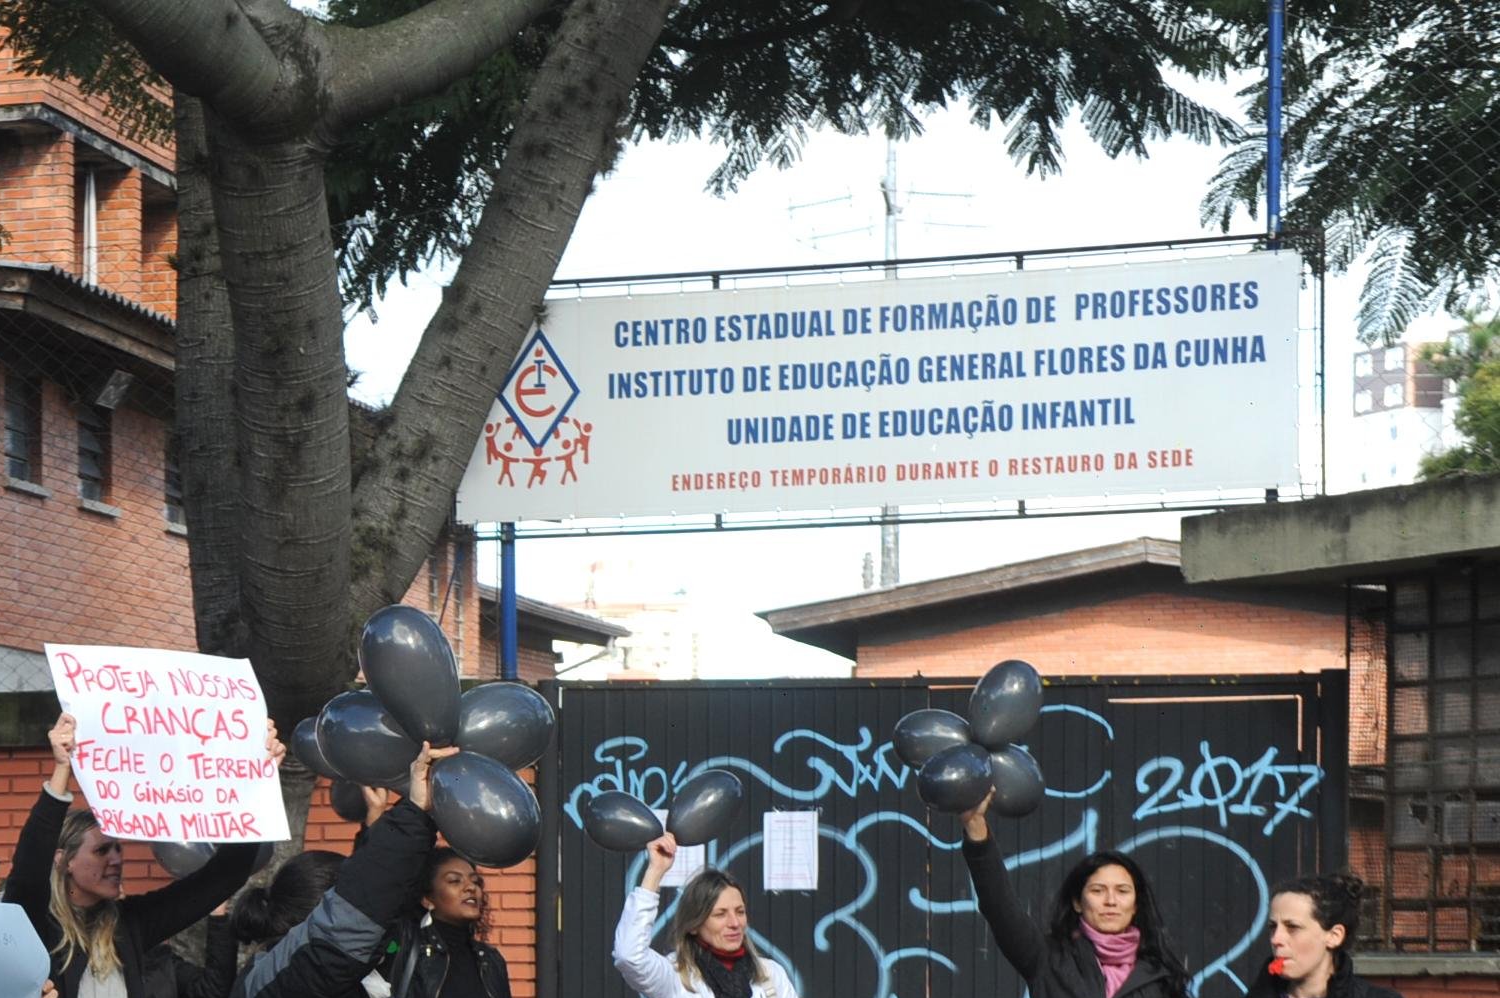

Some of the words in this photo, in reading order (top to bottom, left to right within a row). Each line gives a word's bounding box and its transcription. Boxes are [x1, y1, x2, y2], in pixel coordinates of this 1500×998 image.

[614, 316, 707, 348] CENTRO
[715, 310, 835, 343] ESTADUAL
[843, 307, 871, 335] DE
[879, 294, 1017, 333] FORMAÇÃO
[1026, 296, 1056, 324] DE
[1075, 281, 1259, 321] PROFESSORES
[608, 366, 734, 399] INSTITUTO
[742, 365, 770, 393] DE
[778, 353, 910, 392] EDUCAÇÃO
[918, 351, 1026, 383] GENERAL
[1034, 344, 1126, 377] FLORES
[1133, 342, 1168, 371] DA
[1175, 335, 1266, 368] CUNHA
[727, 414, 834, 445] UNIDADE
[841, 412, 871, 440] DE
[878, 400, 1013, 439] EDUCAÇÃO
[1022, 397, 1135, 430] INFANTIL
[671, 470, 761, 492] ENDEREÇO
[770, 463, 887, 487] TEMPORÁRIO
[896, 459, 979, 481] DURANTE
[988, 459, 999, 477] O
[1008, 453, 1104, 476] RESTAURO
[1114, 452, 1138, 471] DA
[1147, 449, 1194, 469] SEDE
[55, 653, 159, 699] PROTEJA
[168, 668, 257, 701] NOSSAS
[101, 702, 249, 746] CRIANÇAS
[76, 739, 147, 775] FECHE
[160, 753, 174, 773] O
[187, 753, 275, 780] TERRENO
[96, 780, 120, 799] DO
[216, 788, 239, 804] DA
[1132, 741, 1326, 836] 2017
